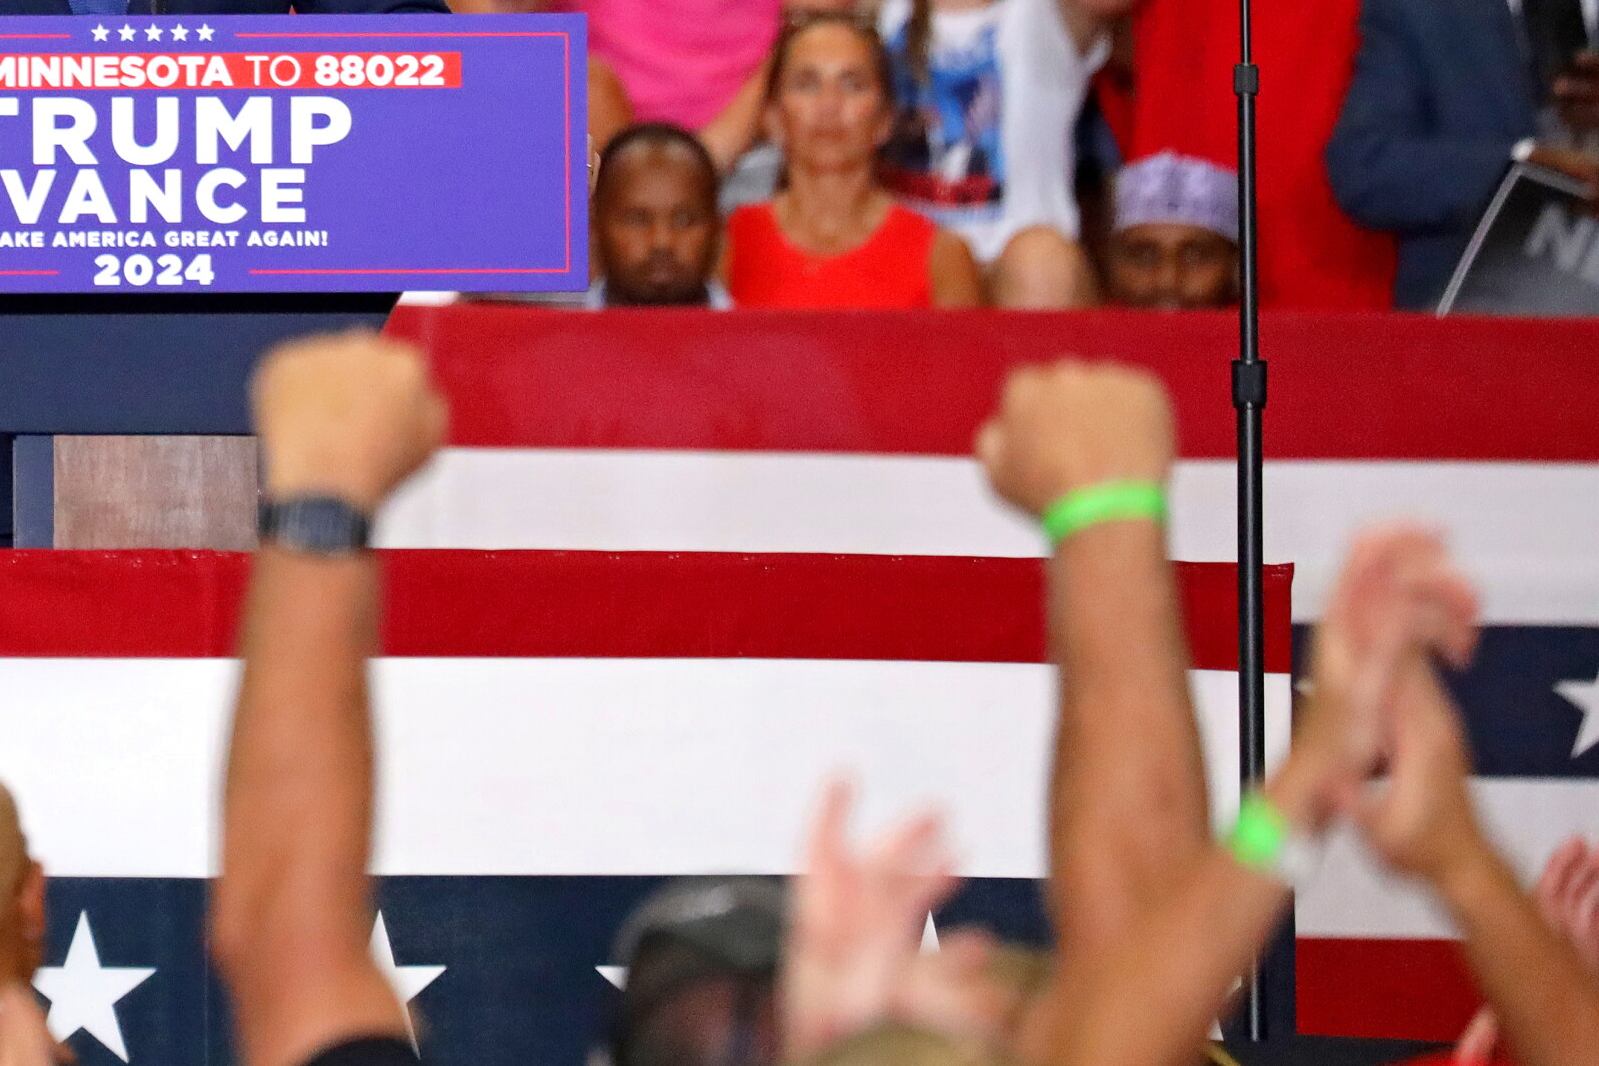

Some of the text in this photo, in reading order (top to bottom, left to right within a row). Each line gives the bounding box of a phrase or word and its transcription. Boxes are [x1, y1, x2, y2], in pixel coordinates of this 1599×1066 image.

[245, 54, 301, 86] TO
[314, 54, 446, 86] 88022
[0, 168, 307, 224] VANCE
[51, 231, 157, 248] AMERICA
[165, 231, 238, 248] GREAT
[246, 230, 328, 247] AGAIN!
[93, 253, 216, 286] 2024
